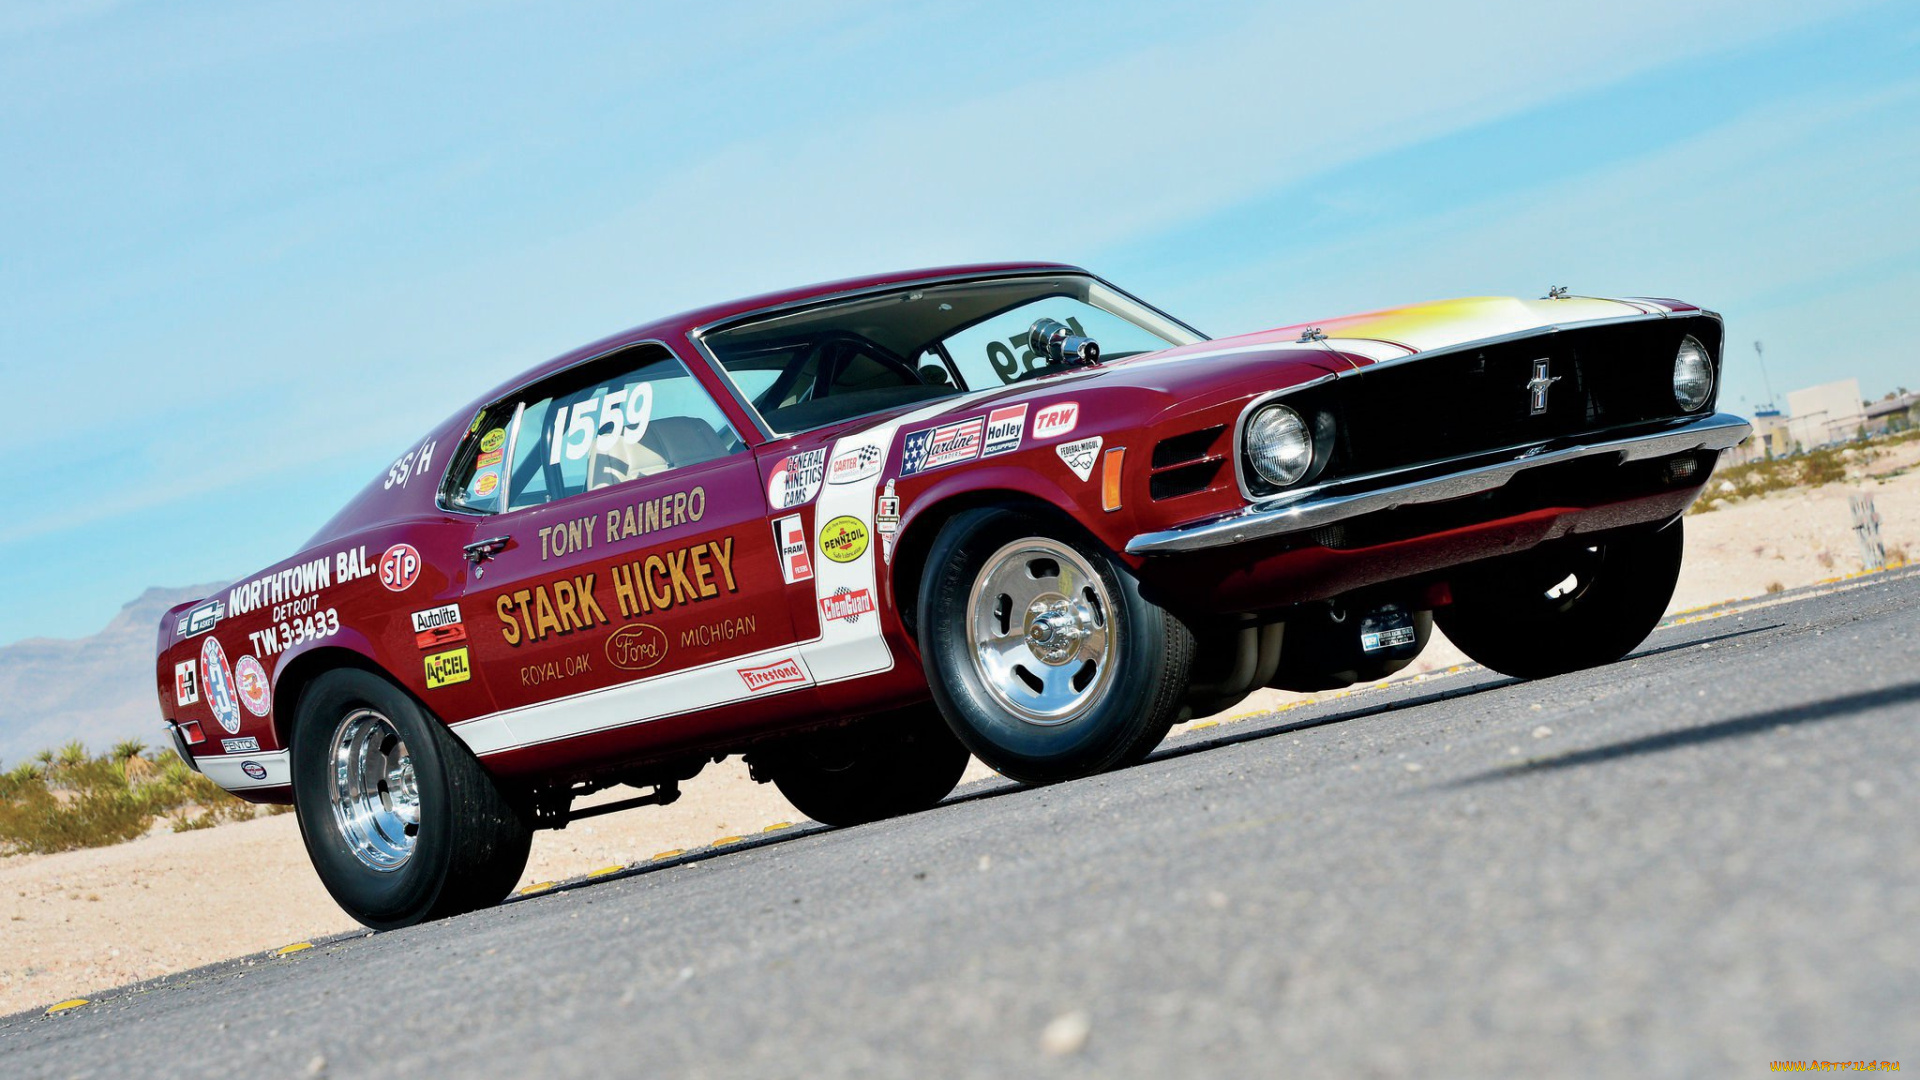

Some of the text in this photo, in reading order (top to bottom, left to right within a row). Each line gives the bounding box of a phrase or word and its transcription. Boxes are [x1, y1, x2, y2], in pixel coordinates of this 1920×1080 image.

[550, 382, 653, 465] 1559
[988, 423, 1021, 440] Holley
[1037, 408, 1075, 429] TRW
[384, 437, 436, 490] SS/H
[786, 449, 823, 472] GENERAL
[917, 428, 974, 471] Jardine
[785, 466, 822, 490] KINETICS
[833, 457, 857, 473] CARTER
[783, 488, 807, 507] CAMS
[539, 486, 706, 560] TONY RAINERO
[783, 544, 803, 555] FRAM
[824, 528, 864, 551] PENNZOIL
[229, 546, 376, 618] NORTHTOWN BAL.
[384, 548, 417, 587] STP
[496, 537, 740, 647] STARK HICKEY
[823, 590, 871, 619] ChemGuard
[272, 594, 319, 623] DETROIT
[418, 608, 457, 630] Autolite
[681, 615, 757, 648] MICHIGAN
[615, 629, 660, 665] Ford
[520, 653, 593, 686] ROYAL OAK
[743, 665, 798, 687] Firestone
